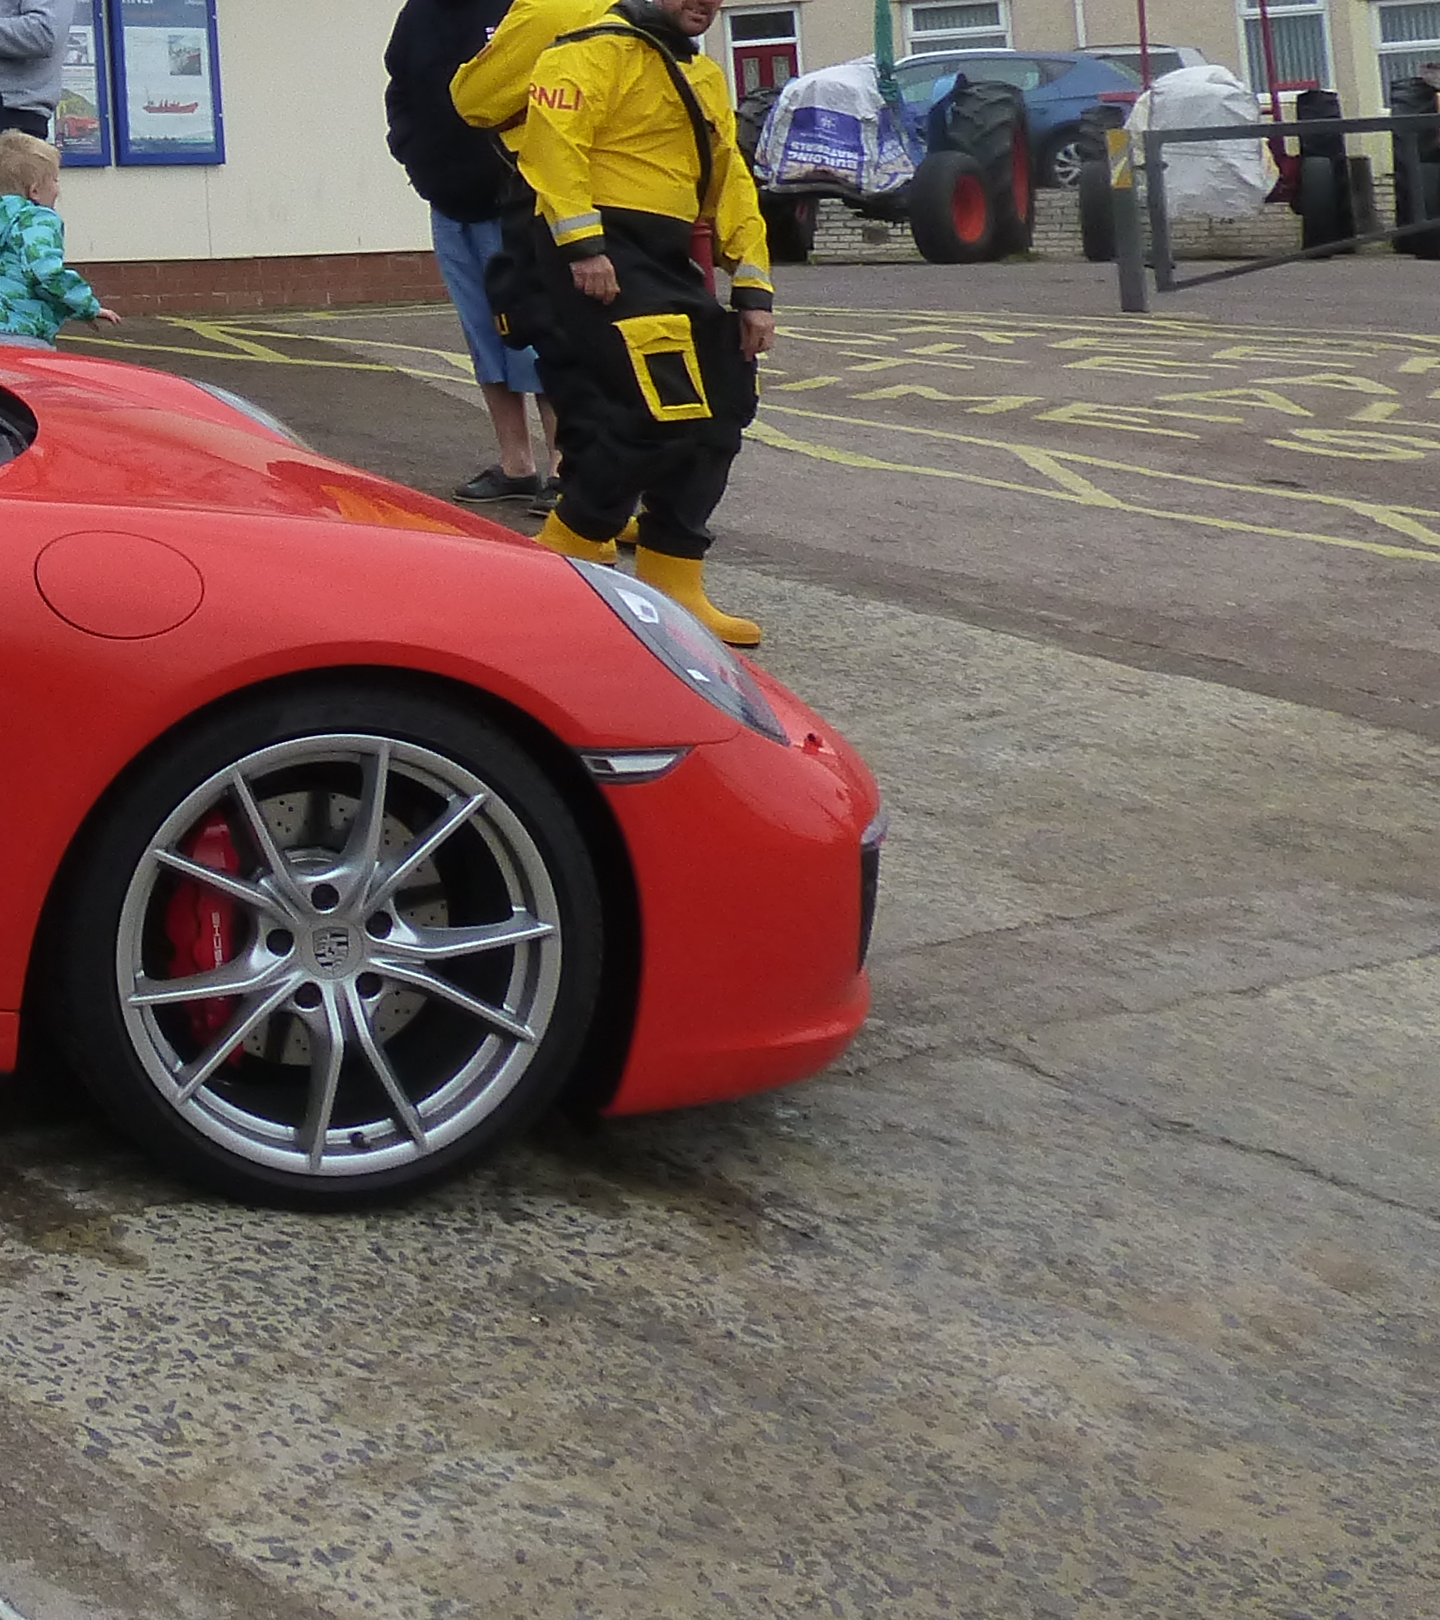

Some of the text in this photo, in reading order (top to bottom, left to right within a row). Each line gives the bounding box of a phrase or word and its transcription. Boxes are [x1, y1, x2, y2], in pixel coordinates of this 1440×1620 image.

[528, 82, 583, 112] RNLI
[787, 150, 859, 170] BUILDING
[789, 140, 859, 160] MATERIALS
